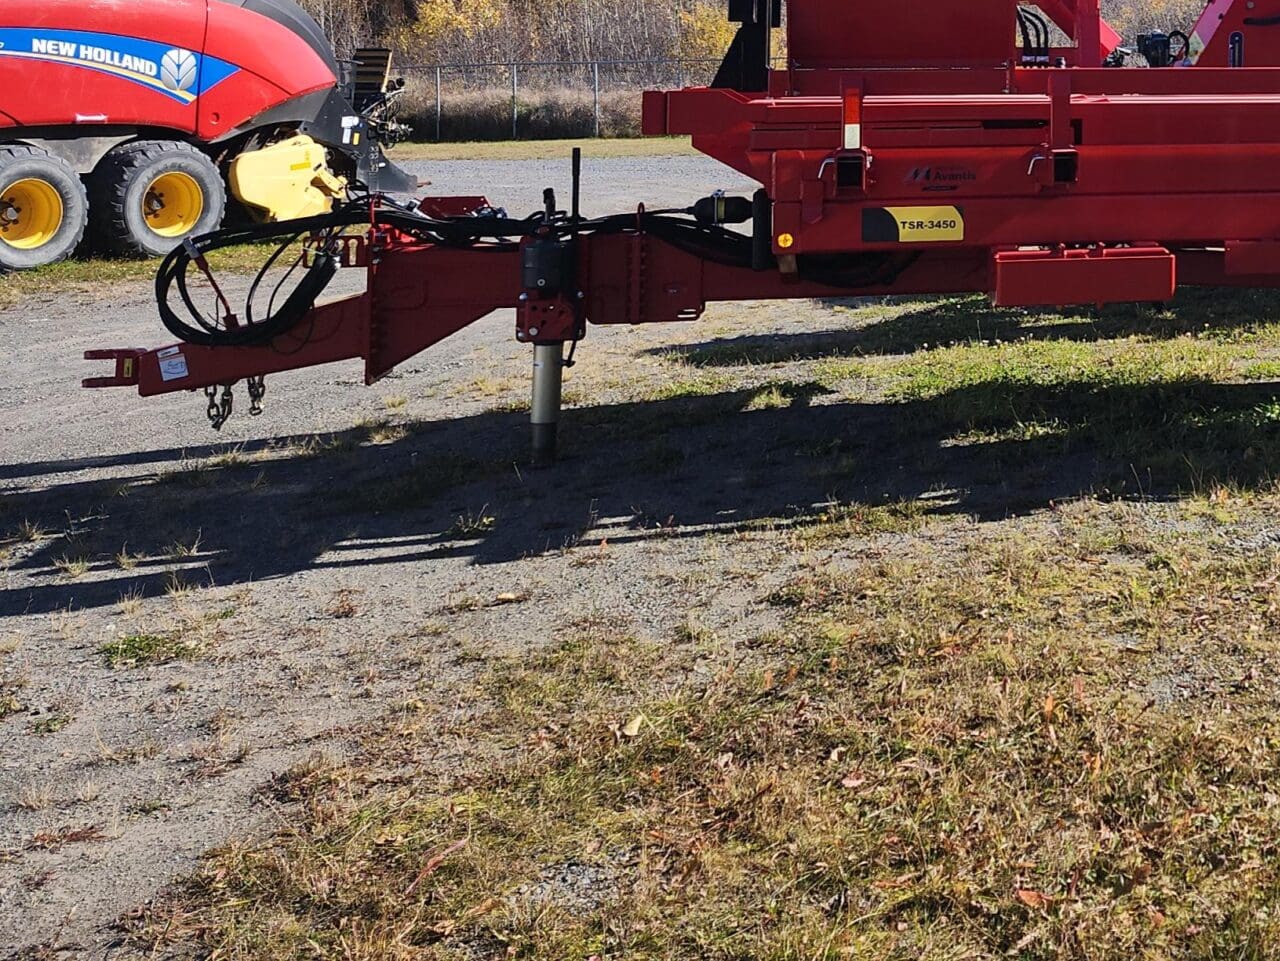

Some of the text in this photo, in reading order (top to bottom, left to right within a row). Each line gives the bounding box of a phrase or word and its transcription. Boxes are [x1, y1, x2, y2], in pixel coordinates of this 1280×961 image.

[32, 39, 157, 76] NEW HOLLAND
[900, 220, 956, 230] TSR-3450
